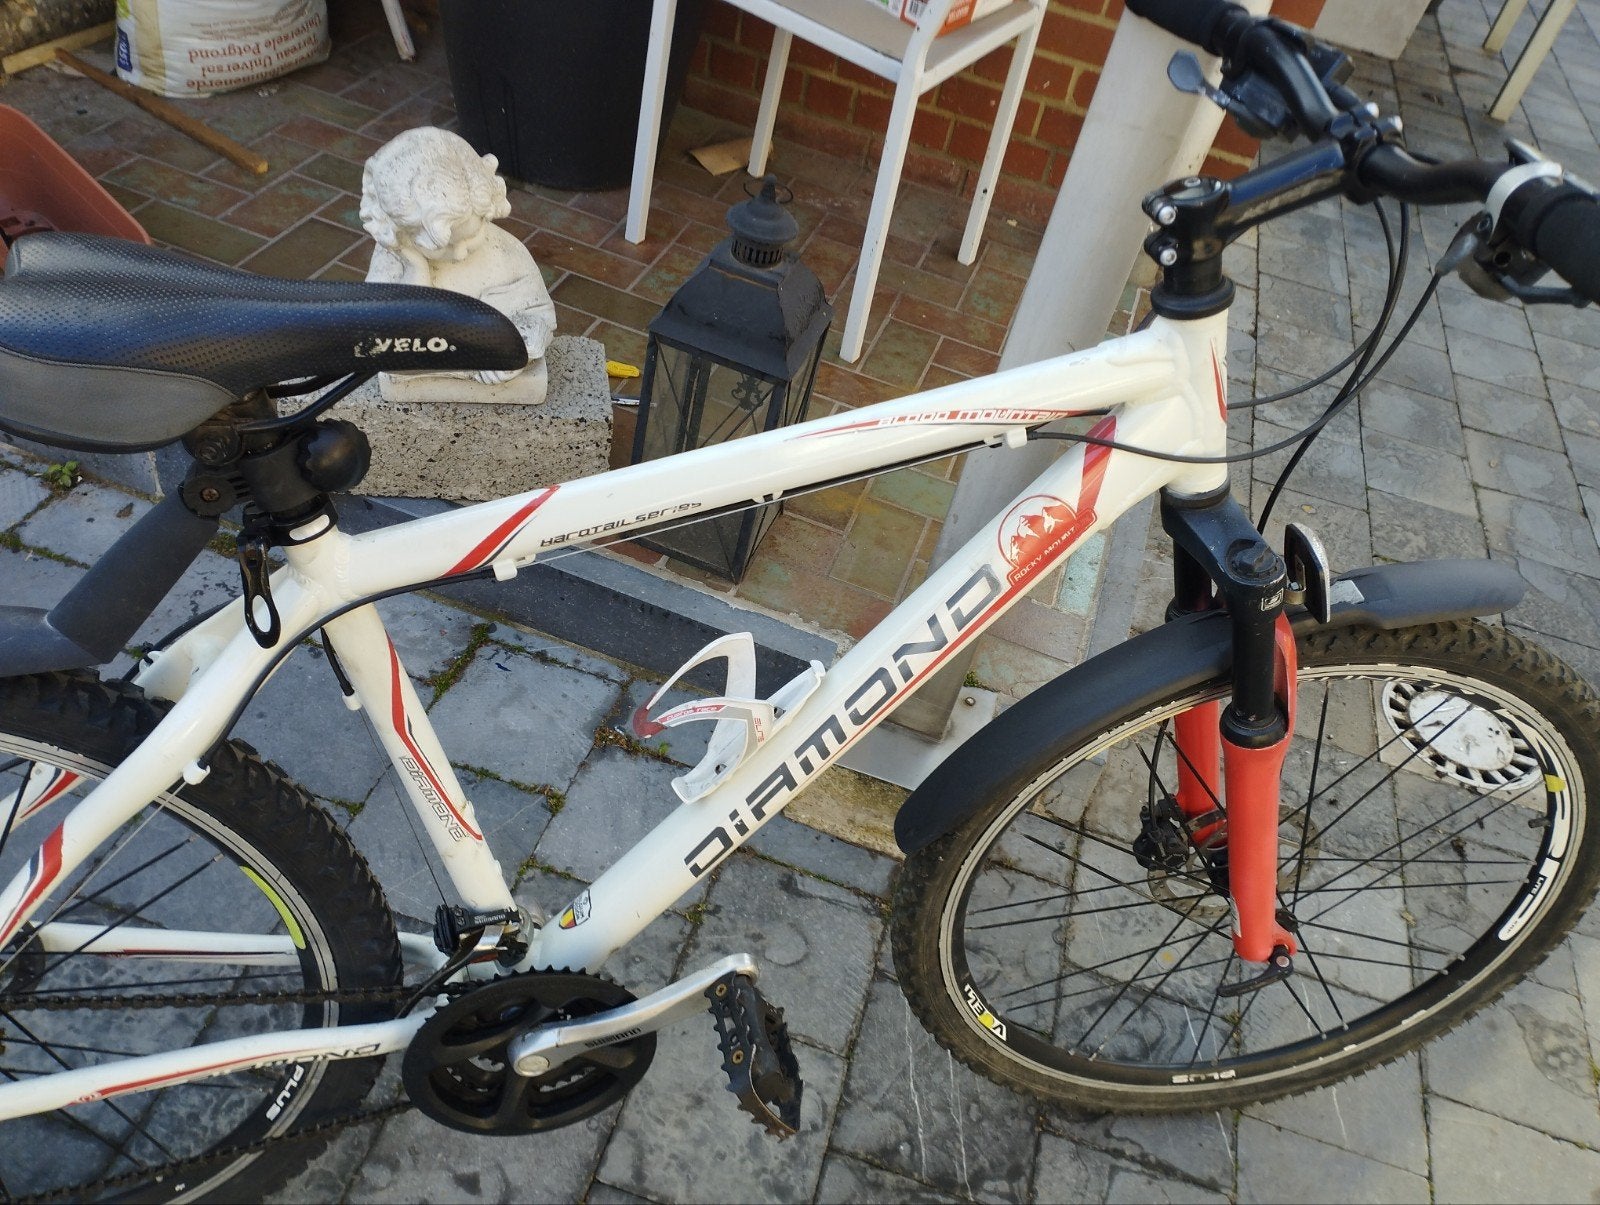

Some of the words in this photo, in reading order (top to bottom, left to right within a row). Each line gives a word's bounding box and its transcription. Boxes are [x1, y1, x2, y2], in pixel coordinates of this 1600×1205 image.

[188, 43, 261, 64] Potgrond
[1013, 554, 1043, 582] ROCKY
[264, 1064, 305, 1122] PLUS
